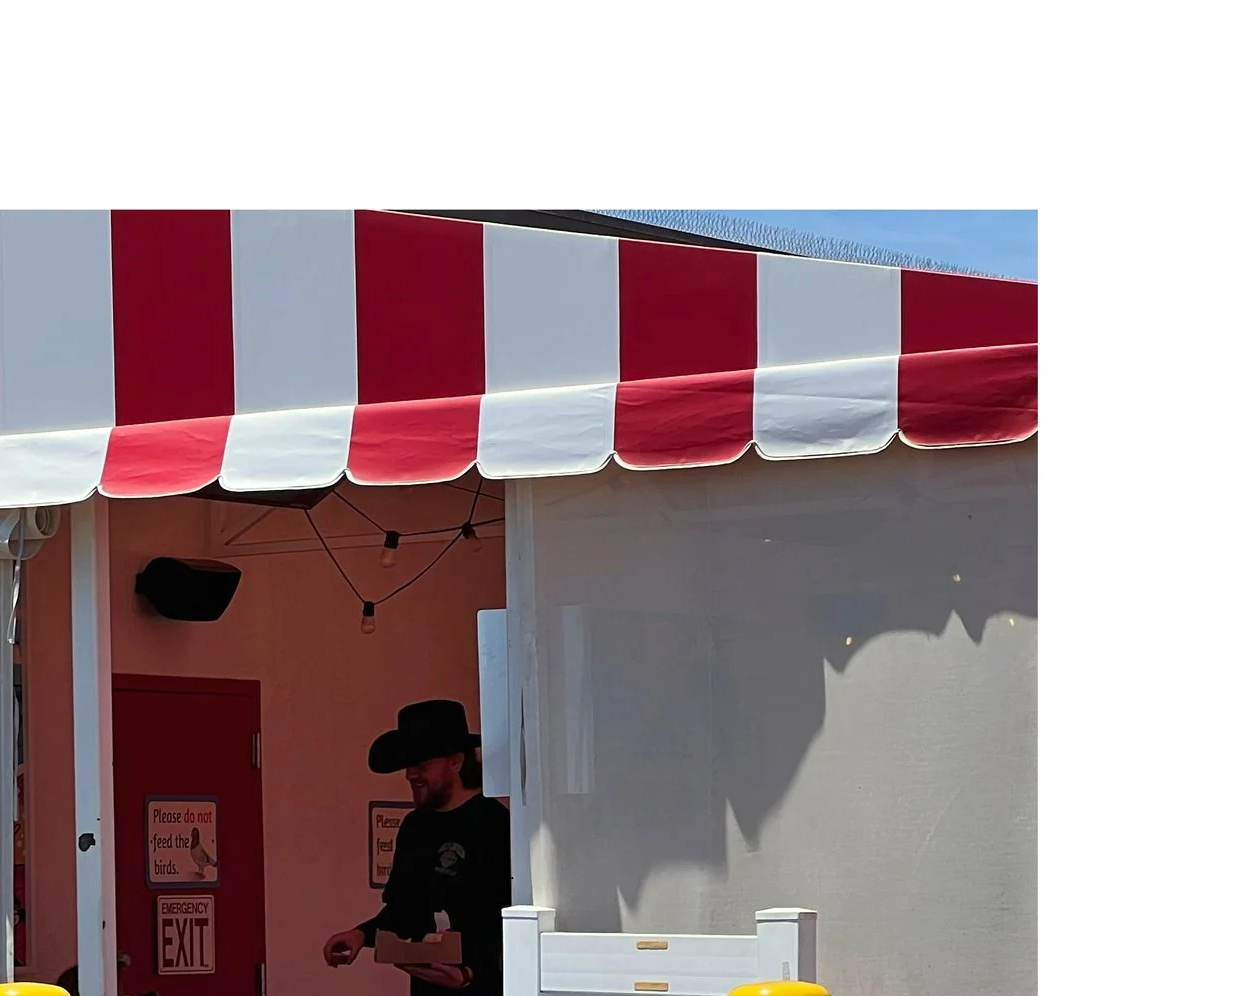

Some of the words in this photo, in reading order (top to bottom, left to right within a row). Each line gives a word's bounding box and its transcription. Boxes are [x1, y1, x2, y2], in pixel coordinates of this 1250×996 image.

[153, 808, 182, 824] Please
[184, 808, 195, 824] do
[197, 811, 213, 824] not
[153, 833, 173, 853] feed
[175, 833, 190, 848] the
[154, 859, 179, 875] birds.
[161, 902, 209, 915] EMERGENCY
[161, 917, 210, 968] EXIT
